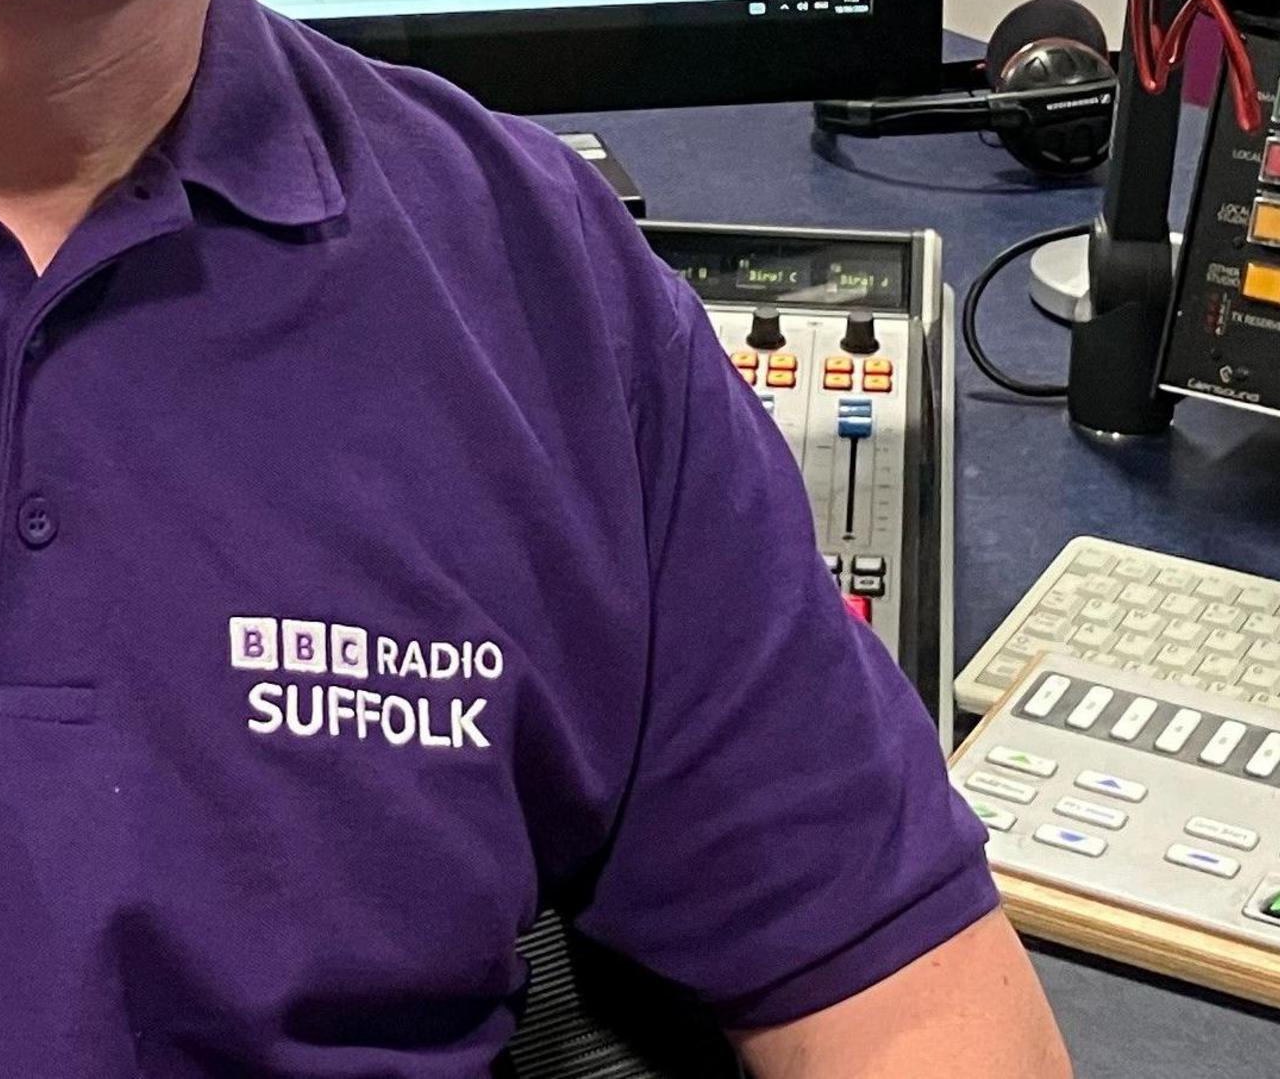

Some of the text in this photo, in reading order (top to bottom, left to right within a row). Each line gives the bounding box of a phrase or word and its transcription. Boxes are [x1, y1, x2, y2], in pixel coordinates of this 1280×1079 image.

[229, 616, 504, 680] BBC RADIO
[247, 681, 491, 749] SUFFOLK
